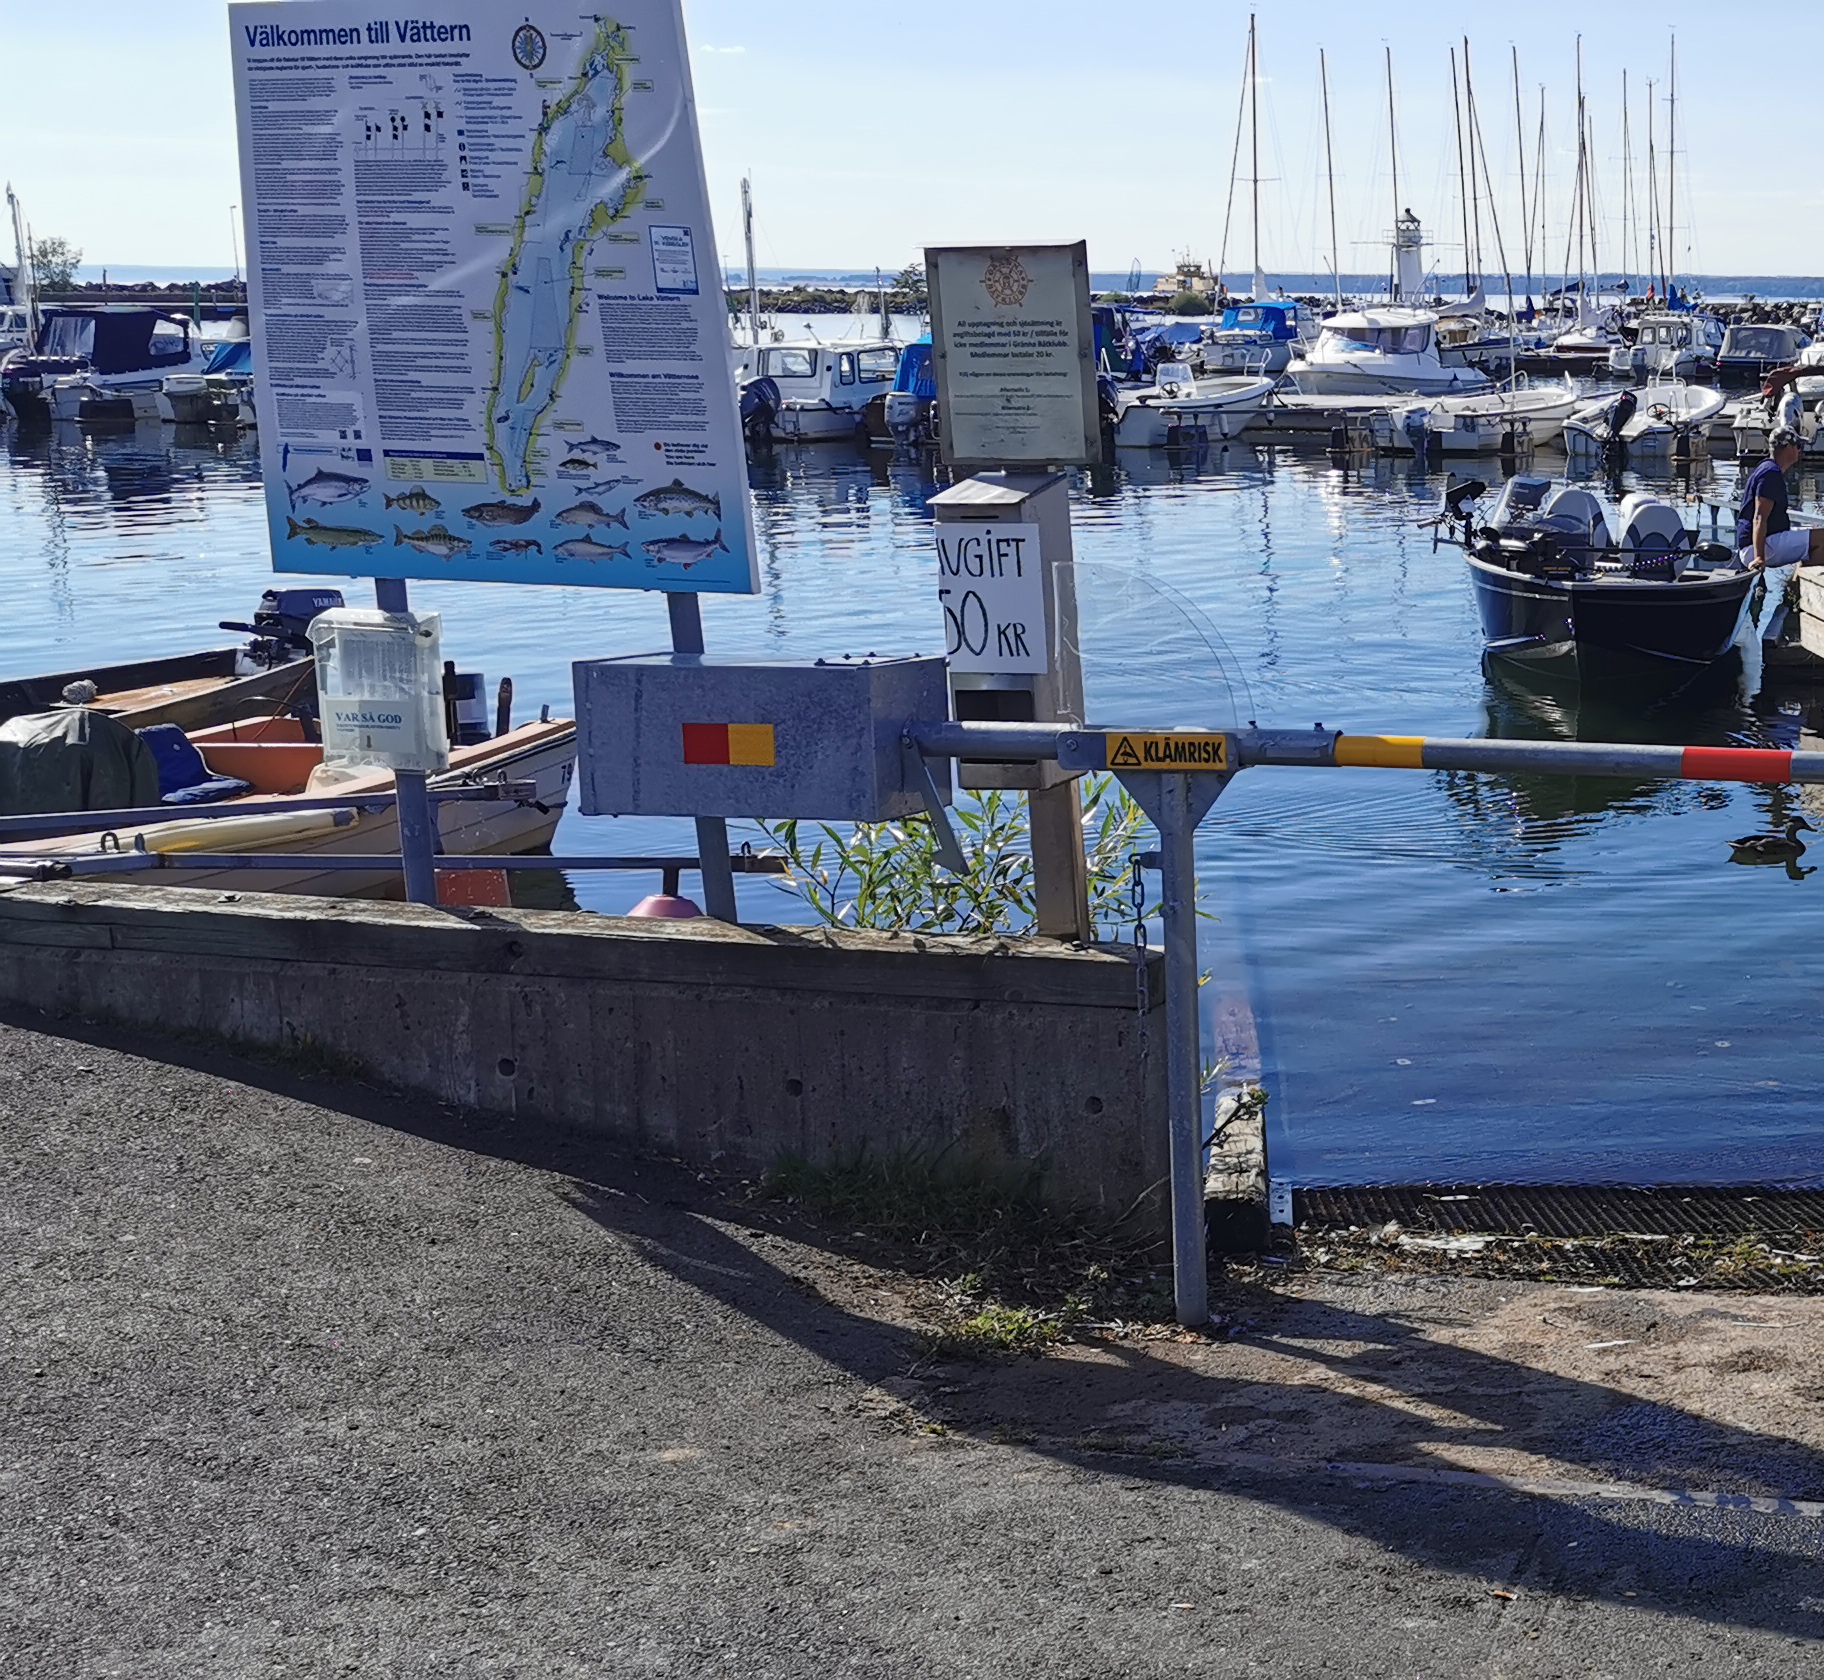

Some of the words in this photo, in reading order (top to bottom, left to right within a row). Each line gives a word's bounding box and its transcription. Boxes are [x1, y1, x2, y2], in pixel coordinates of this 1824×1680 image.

[245, 24, 361, 47] Välkommen
[366, 21, 390, 44] till
[395, 19, 472, 43] Vättern
[939, 589, 989, 656] 50
[997, 622, 1030, 657] KR
[335, 712, 359, 723] VAR
[360, 711, 375, 723] SÅ
[377, 713, 402, 724] GOD
[1143, 736, 1223, 763] KLÄMRISK
